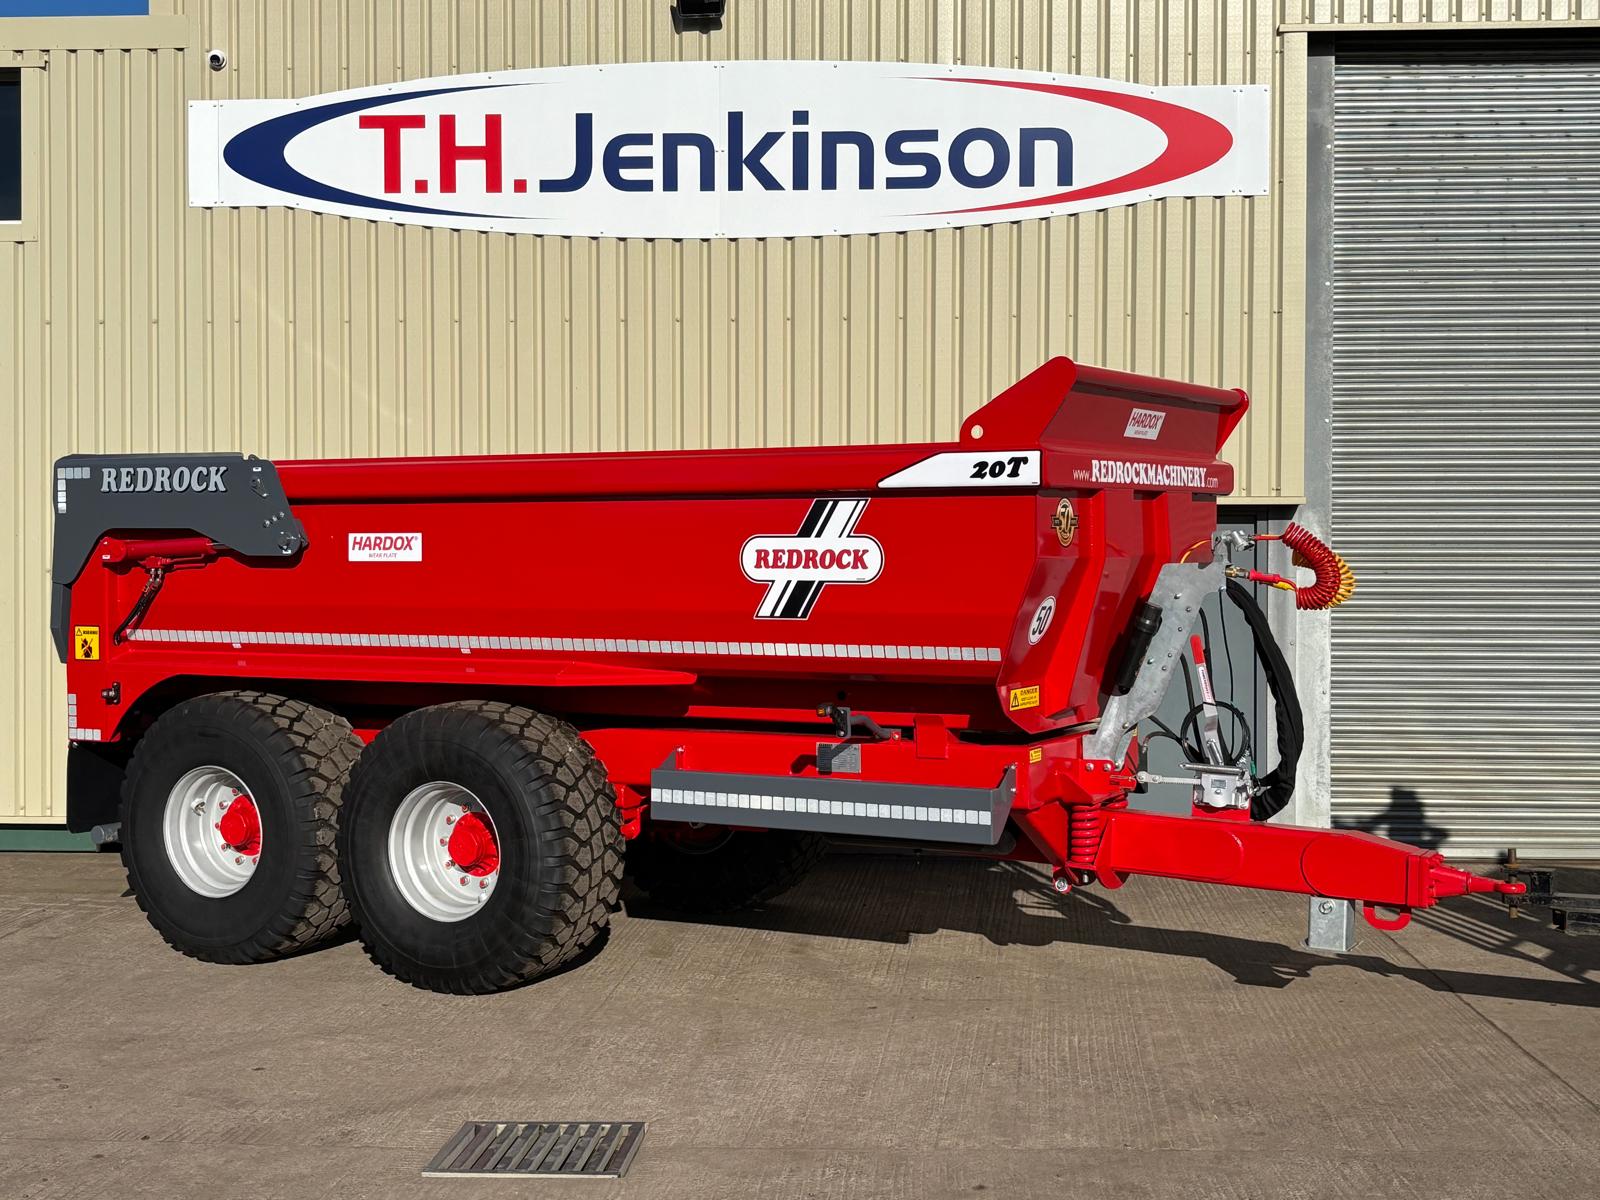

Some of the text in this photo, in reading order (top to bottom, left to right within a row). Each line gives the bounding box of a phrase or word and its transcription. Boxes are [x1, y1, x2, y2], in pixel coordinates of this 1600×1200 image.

[538, 110, 1074, 193] Jenkinson
[100, 466, 227, 493] REDROCK
[969, 456, 1029, 479] 20T
[754, 549, 869, 569] REDROCK
[1031, 605, 1053, 636] 50
